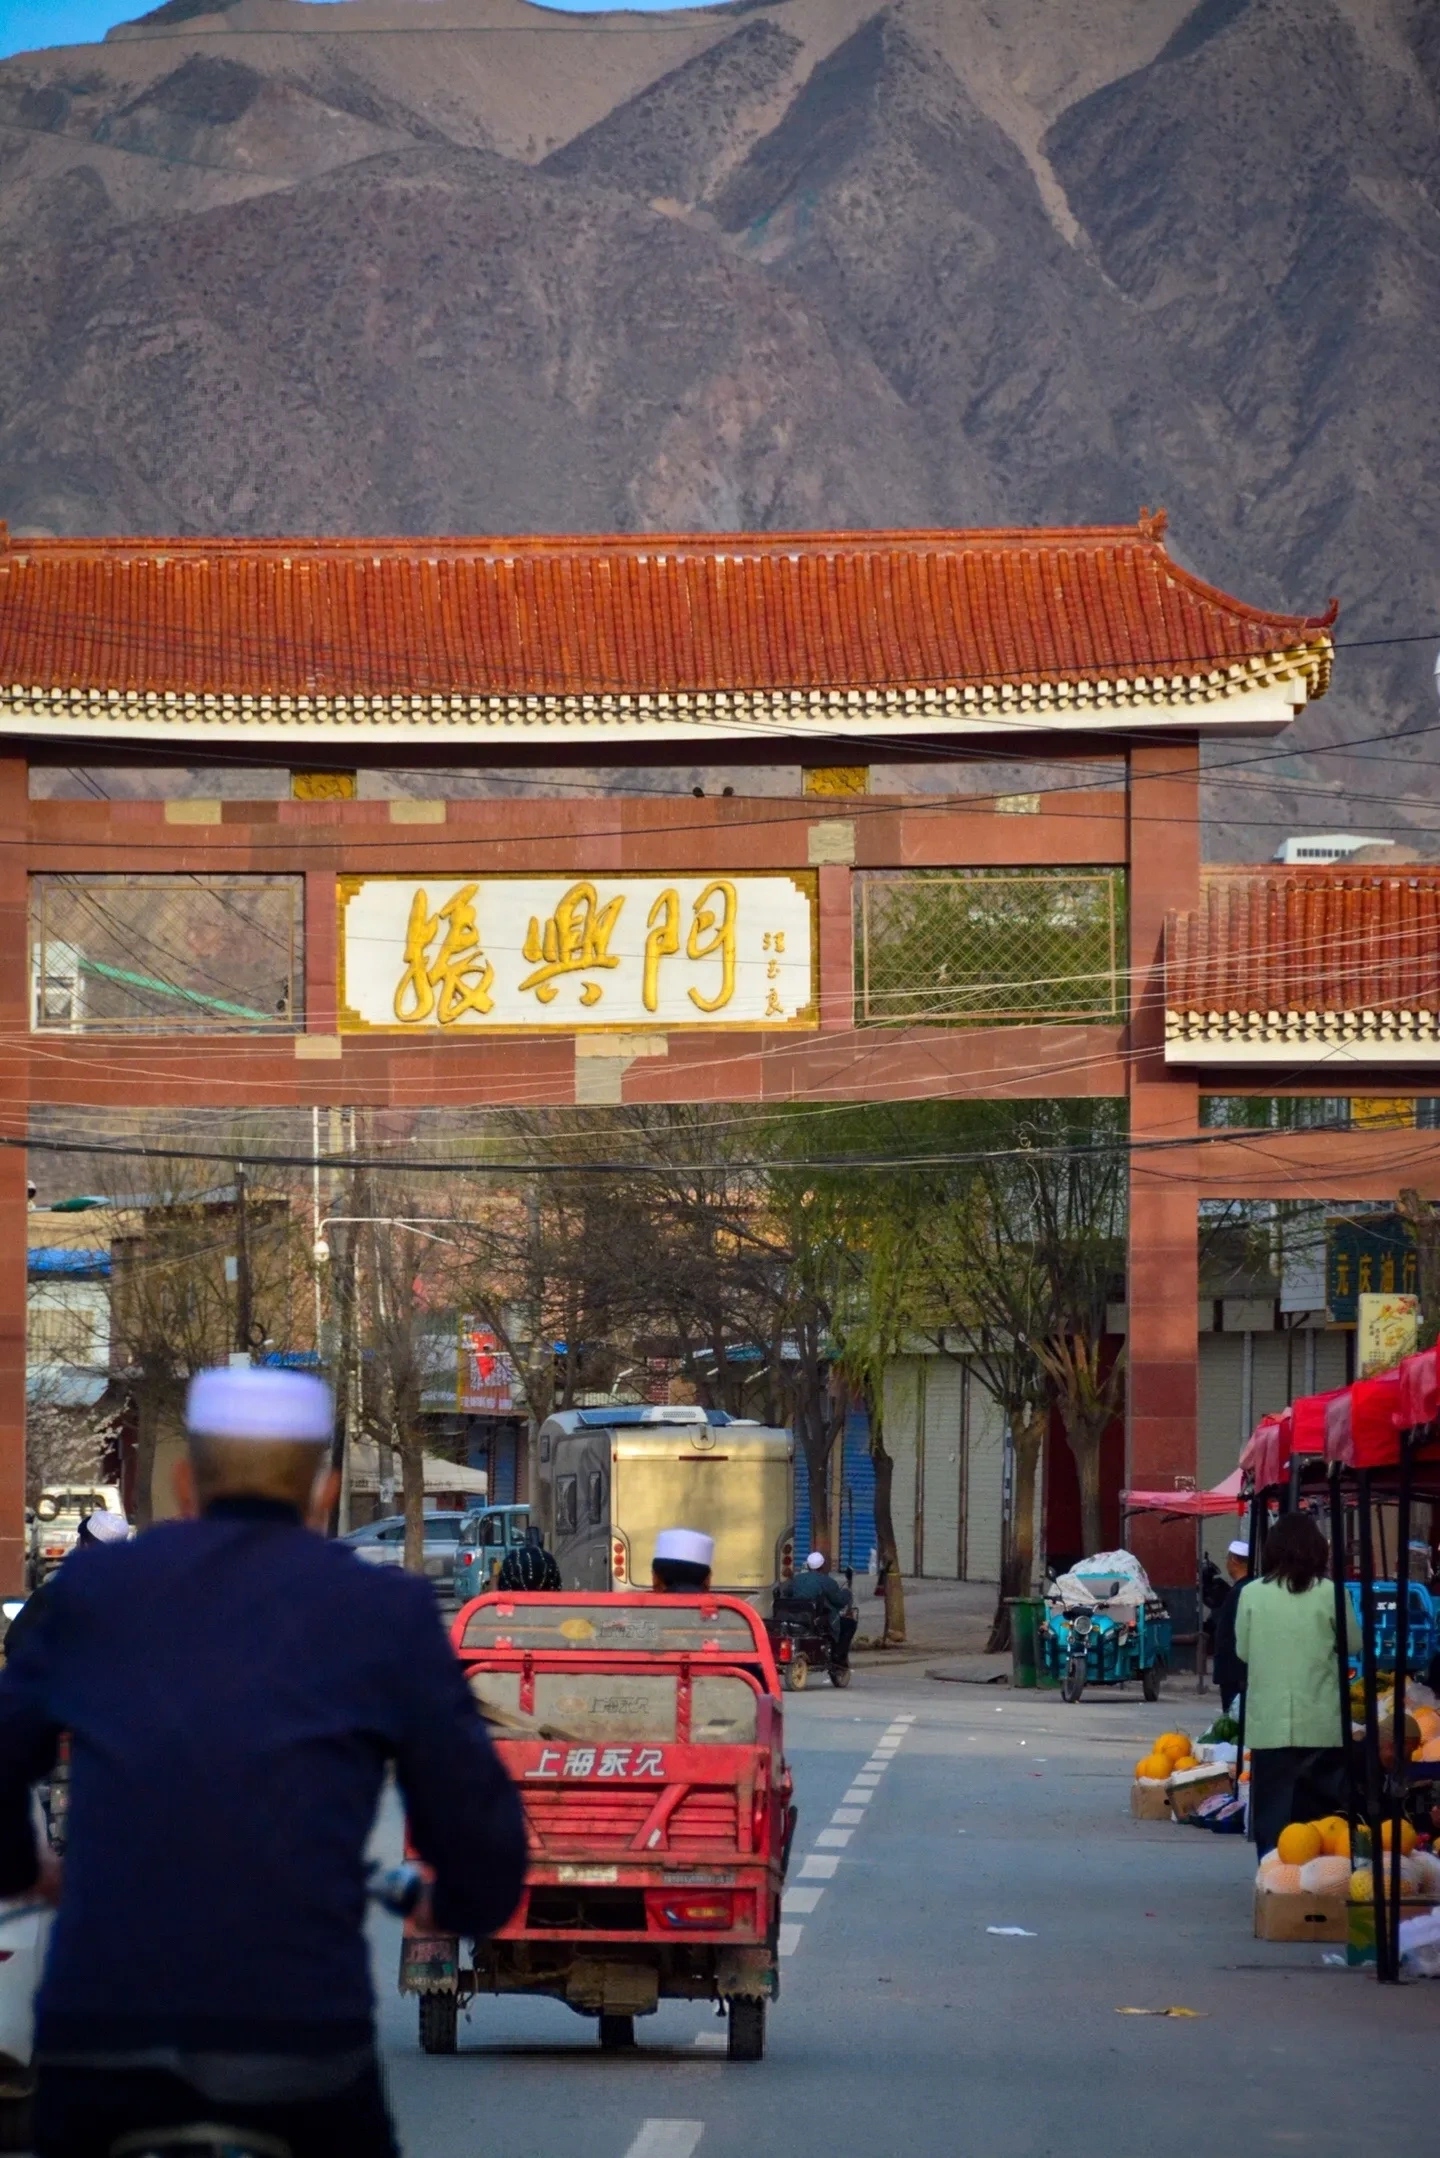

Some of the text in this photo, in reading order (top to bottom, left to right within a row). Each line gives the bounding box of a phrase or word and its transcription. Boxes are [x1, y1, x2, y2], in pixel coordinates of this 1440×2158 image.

[588, 1696, 650, 1715] 上海永久
[524, 1748, 665, 1778] 上海永久
